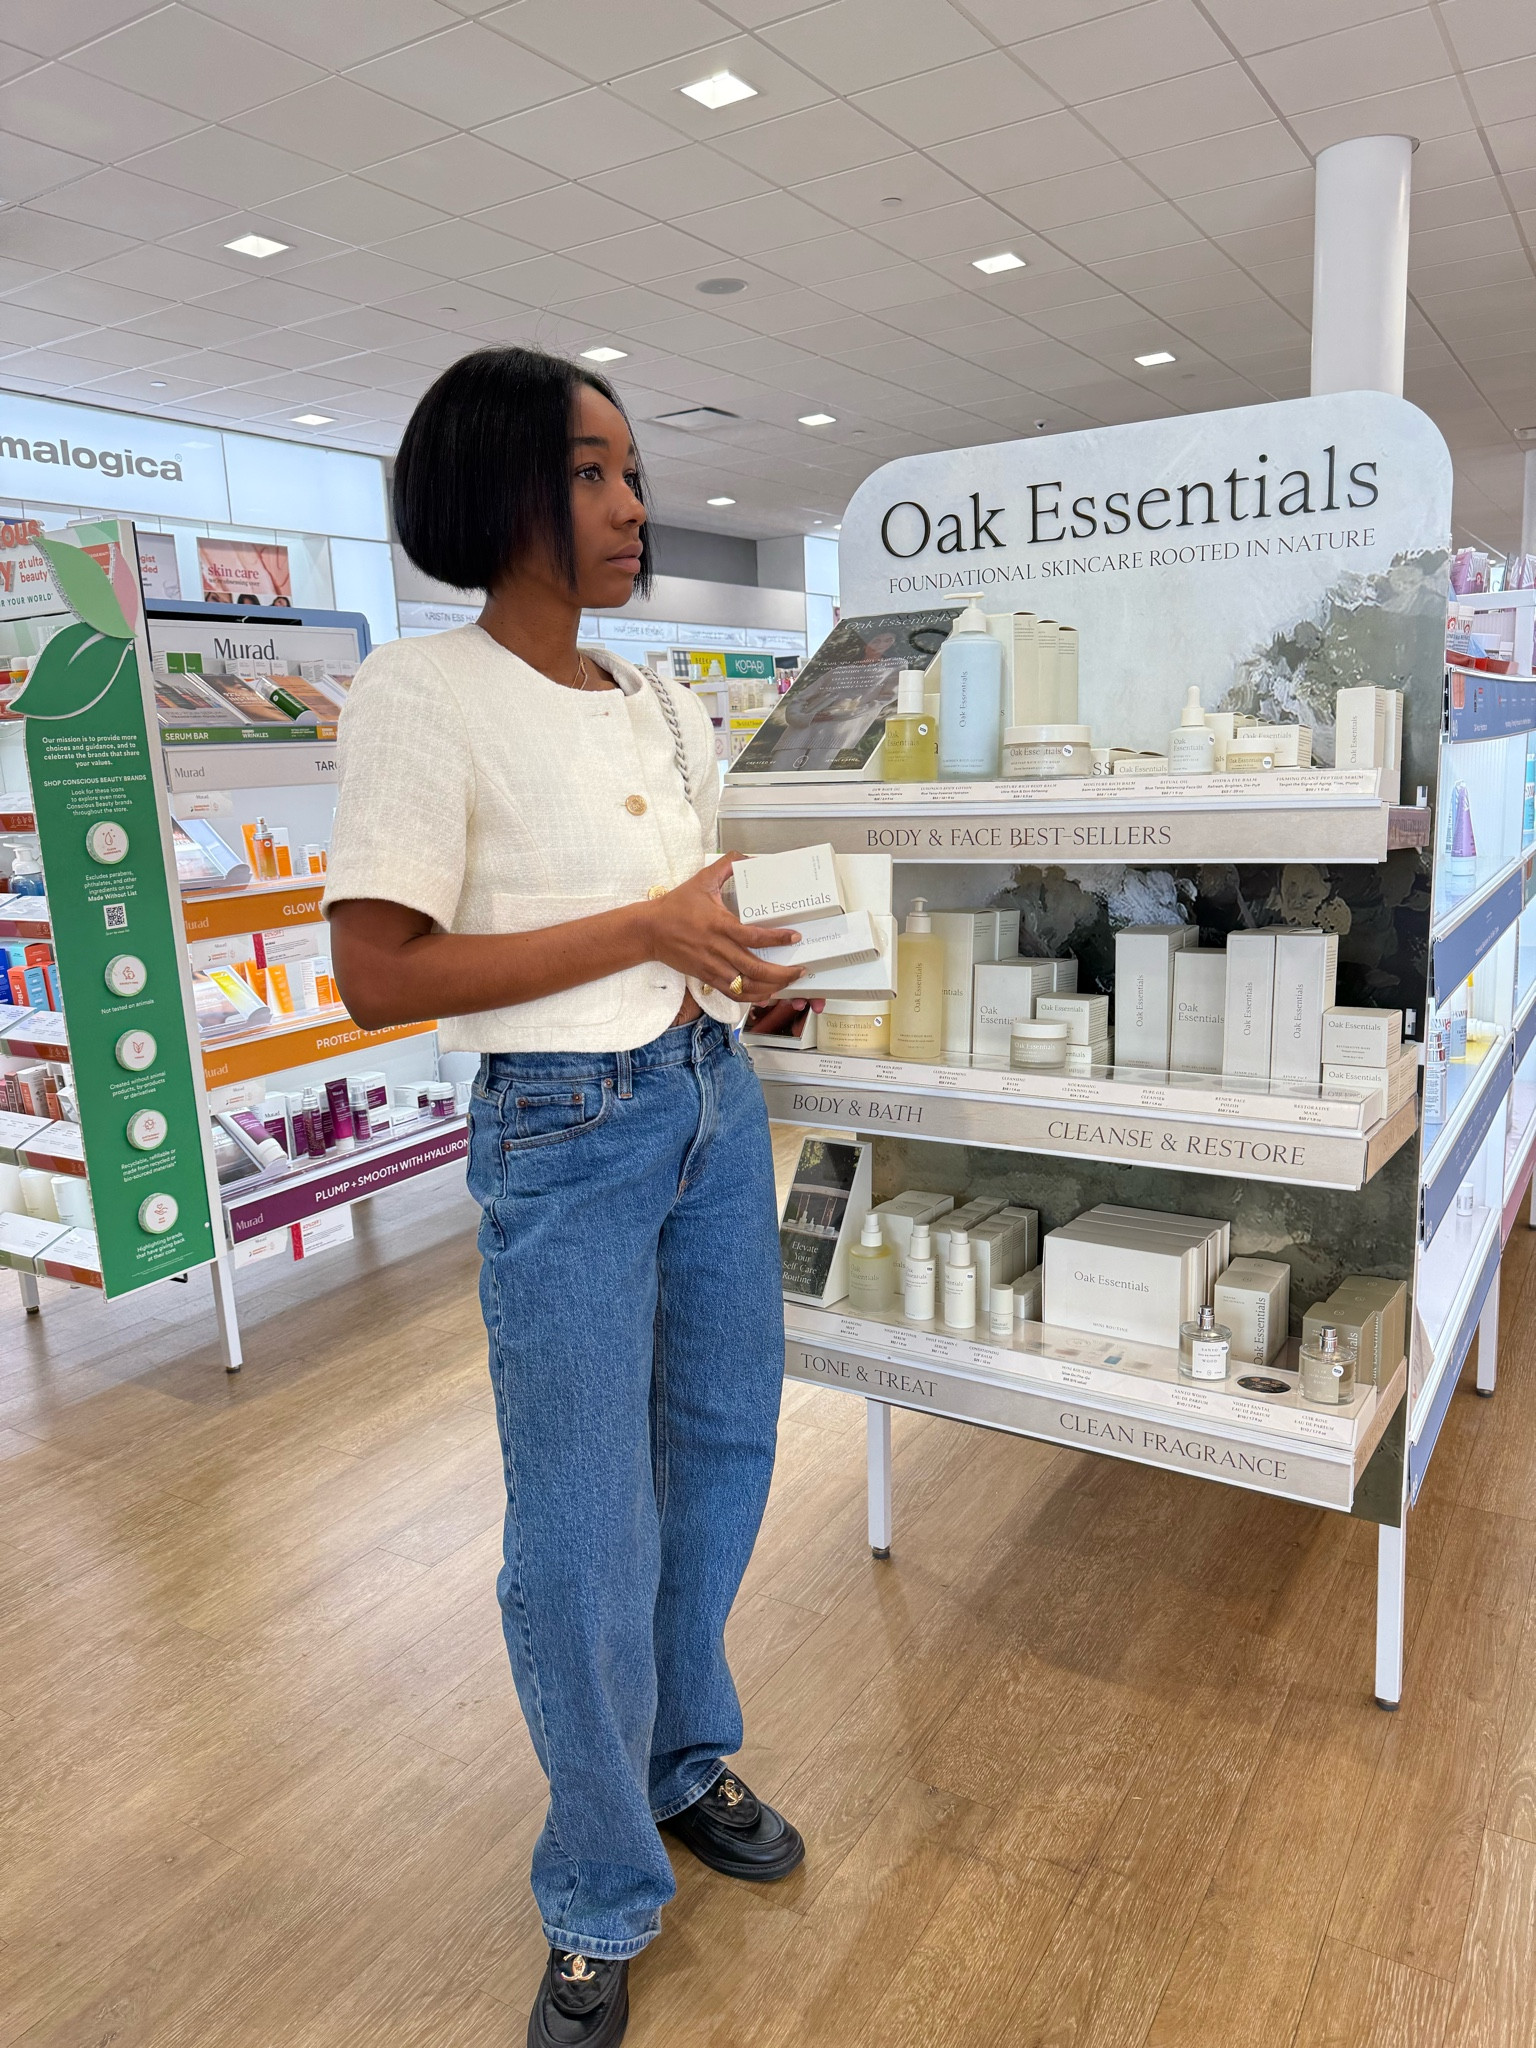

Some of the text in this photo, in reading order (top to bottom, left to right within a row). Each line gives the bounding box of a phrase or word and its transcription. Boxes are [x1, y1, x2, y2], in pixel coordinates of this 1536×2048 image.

[881, 445, 1379, 558] Oak Essentials
[18, 556, 44, 569] at ulta
[888, 527, 1376, 594] FOUNDATIONAL SKINCARE ROOTED IN NATURE
[20, 570, 48, 583] beauty
[208, 564, 259, 579] skin care
[7, 597, 25, 606] YOUR
[27, 594, 52, 603] WORLD
[844, 613, 954, 630] Oak Essentials
[735, 660, 764, 674] KOPARI
[960, 671, 969, 728] Oak Essentials
[42, 736, 55, 744] Our
[97, 734, 120, 742] provide
[165, 732, 208, 741] SERUM BAR
[1350, 715, 1358, 764] Oak Essentials
[86, 743, 115, 751] guidance,
[1174, 744, 1204, 752] Essentials
[175, 767, 205, 778] Murad
[1134, 765, 1168, 773] Essentials
[63, 778, 99, 786] CONSCIOUS
[866, 826, 1171, 847] BODY & FACE BEST-SELLERS
[86, 873, 108, 881] Excludes
[84, 880, 112, 888] phthalates,
[89, 886, 117, 895] ingredients
[105, 892, 126, 900] Without
[282, 902, 316, 916] GLOW
[742, 892, 832, 918] Oak Essentials
[806, 932, 842, 944] Essentials
[914, 962, 922, 1013] Oak Essentials
[112, 1004, 128, 1012] tested
[136, 999, 154, 1007] animals
[1136, 974, 1144, 1027] Oak Essentials
[1294, 983, 1304, 1022] Essentials
[980, 1006, 998, 1014] Oak
[1054, 1005, 1084, 1013] Essentials
[1178, 1002, 1225, 1024] Oak Essentials
[1244, 982, 1253, 1036] Oak Essentials
[839, 1021, 872, 1029] Essentials
[1344, 1021, 1381, 1031] Essentials
[316, 1030, 362, 1050] PROTECT
[1328, 1071, 1382, 1082] Oak Essentials
[792, 1094, 923, 1123] BODY & BATH
[1048, 1120, 1306, 1166] CLEANSE & RESTORE
[316, 1182, 350, 1202] PLUMP
[351, 1180, 357, 1188] +
[358, 1164, 399, 1186] SMOOTH
[400, 1155, 423, 1171] WITH
[236, 1214, 264, 1231] Murad
[792, 1241, 819, 1254] Elevate
[794, 1252, 811, 1262] Your
[782, 1272, 812, 1284] Routine
[1074, 1271, 1150, 1293] Oak Essentials
[1254, 1297, 1266, 1366] Oak Essentials
[800, 1352, 938, 1397] TONE & TREAT
[1060, 1412, 1288, 1480] CLEAN FRAGRANCE
